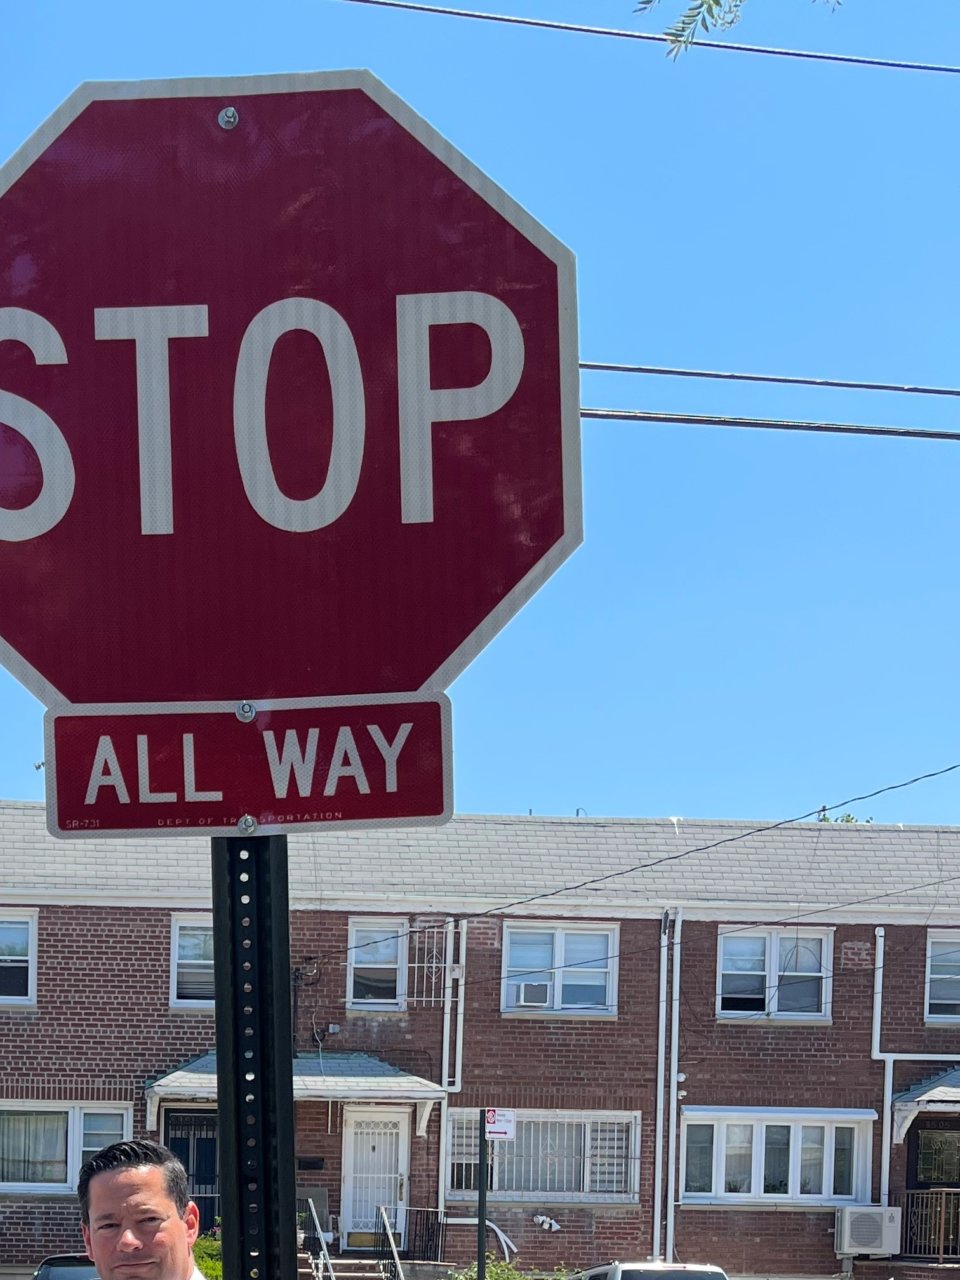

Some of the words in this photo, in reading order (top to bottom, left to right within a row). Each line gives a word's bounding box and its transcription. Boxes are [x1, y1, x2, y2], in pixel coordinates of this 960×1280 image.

[84, 733, 223, 805] ALL
[263, 722, 414, 799] WAY
[65, 818, 100, 829] SR-731
[157, 817, 191, 826] DEPT
[198, 817, 214, 825] OF
[223, 811, 342, 824] TRSPORTATION
